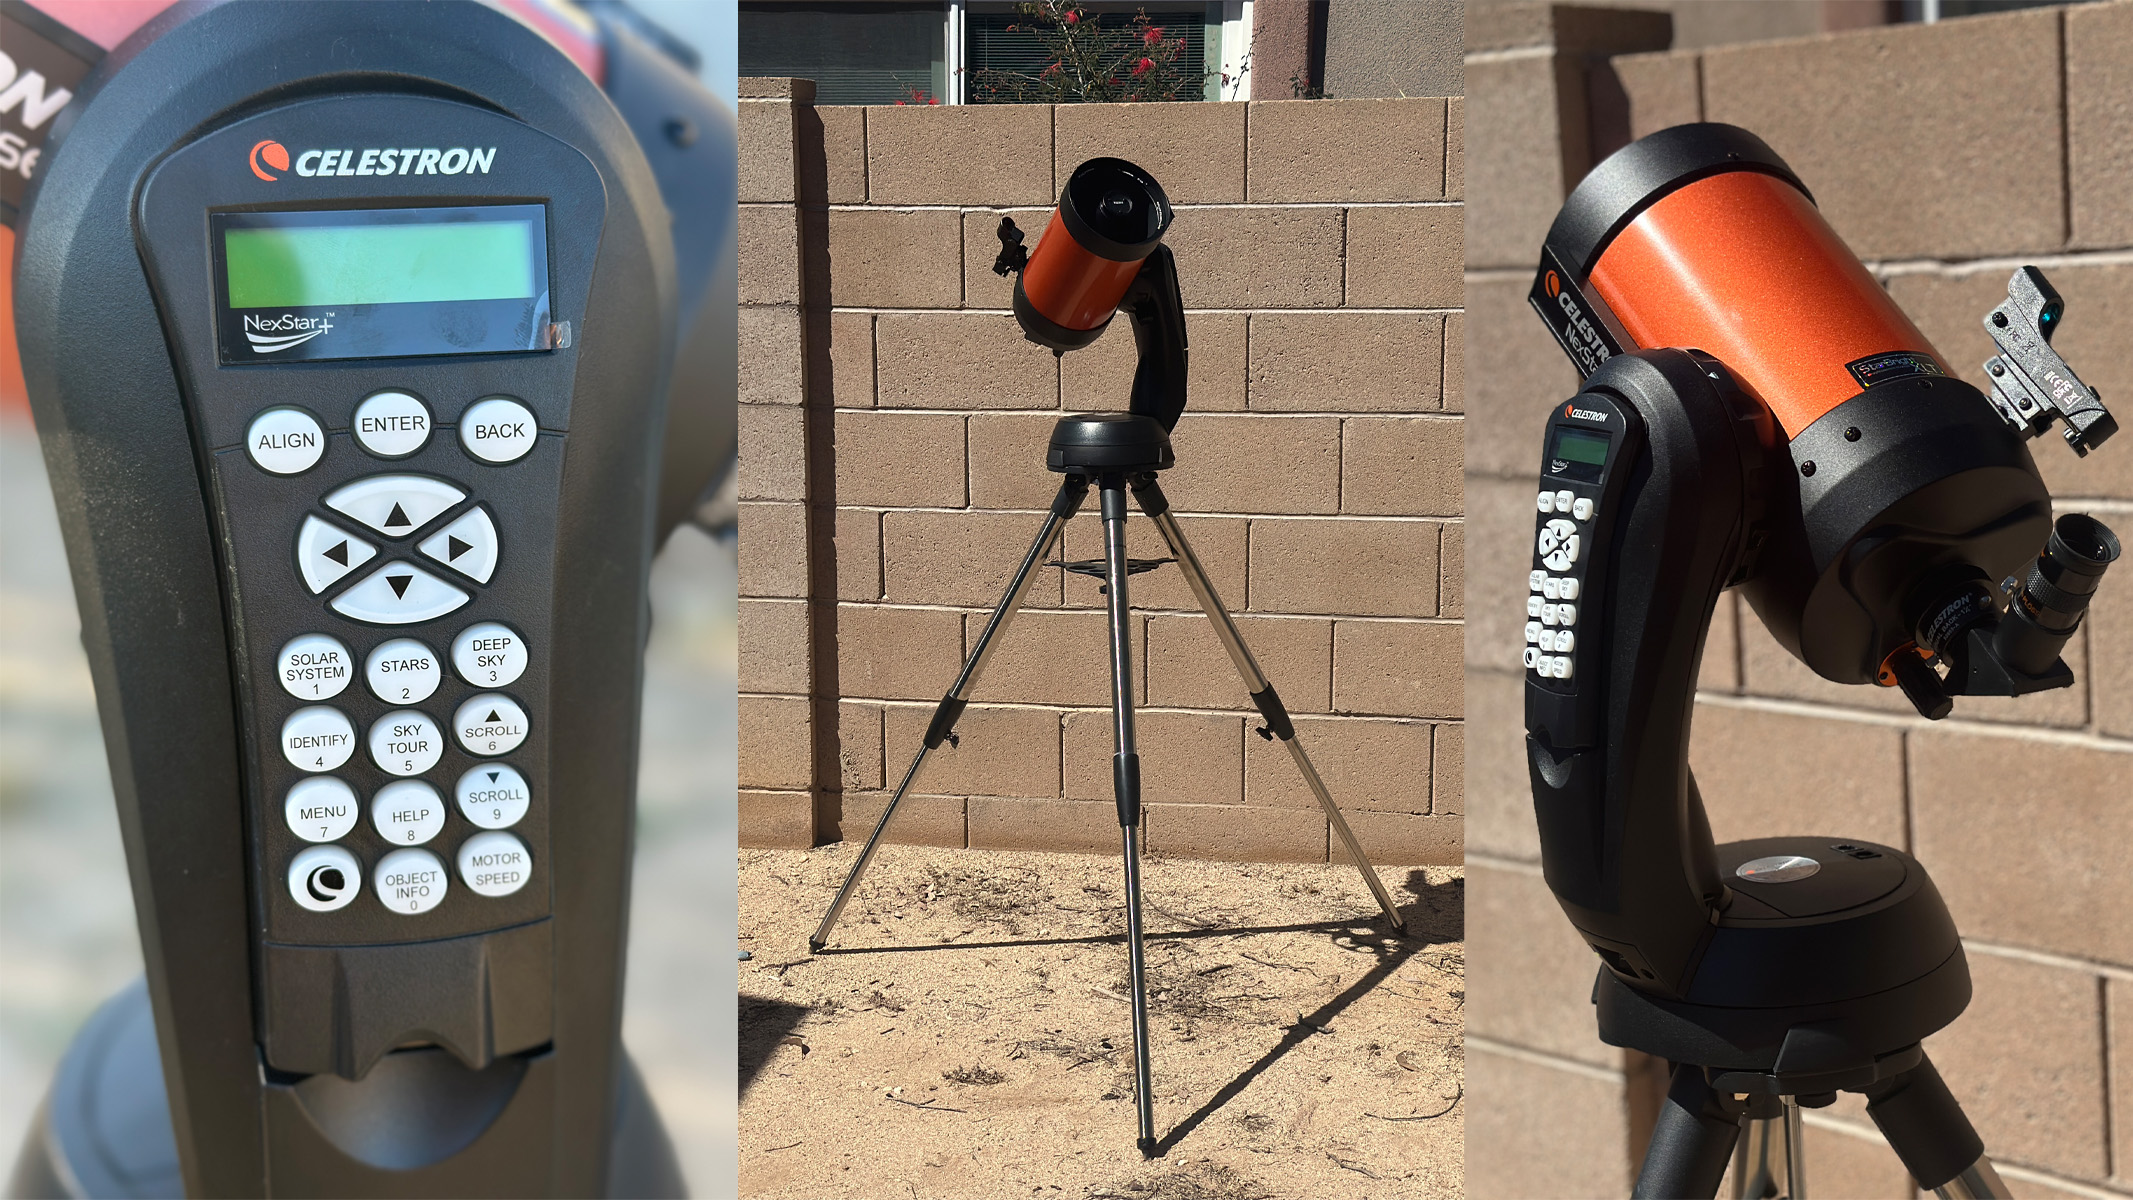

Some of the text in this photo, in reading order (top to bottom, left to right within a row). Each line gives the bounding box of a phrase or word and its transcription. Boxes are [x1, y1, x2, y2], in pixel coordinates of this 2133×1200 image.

[296, 148, 497, 177] CELESTRON
[1558, 291, 1613, 363] CELESTR
[1572, 409, 1608, 422] CELESTRON
[361, 415, 426, 433] ENTER
[475, 423, 526, 440] BACK
[258, 433, 316, 450] ALIGN
[472, 637, 512, 652] DEEP
[291, 652, 339, 667] SOLAR
[381, 658, 430, 673] STARS
[477, 655, 507, 667] SKY
[286, 666, 345, 681] SYSTEM
[489, 671, 498, 682] 3
[313, 685, 319, 695] 1
[402, 688, 410, 699] 2
[393, 724, 423, 737] SKY
[465, 725, 522, 738] SCROLL
[290, 734, 348, 749] IDENTIFY
[387, 741, 429, 754] TOUR
[488, 741, 497, 751] 6
[315, 757, 324, 767] 4
[405, 760, 413, 771] 5
[469, 789, 524, 804] SCROLL
[300, 805, 347, 820] MENU
[392, 809, 430, 823] HELP
[493, 809, 501, 820] 9
[320, 826, 328, 837] 7
[407, 830, 415, 841] 8
[472, 852, 521, 867] MOTOR
[385, 871, 438, 886] OBJECT
[475, 871, 520, 886] SPEED
[396, 886, 430, 899] INFO
[410, 900, 418, 911] 0
